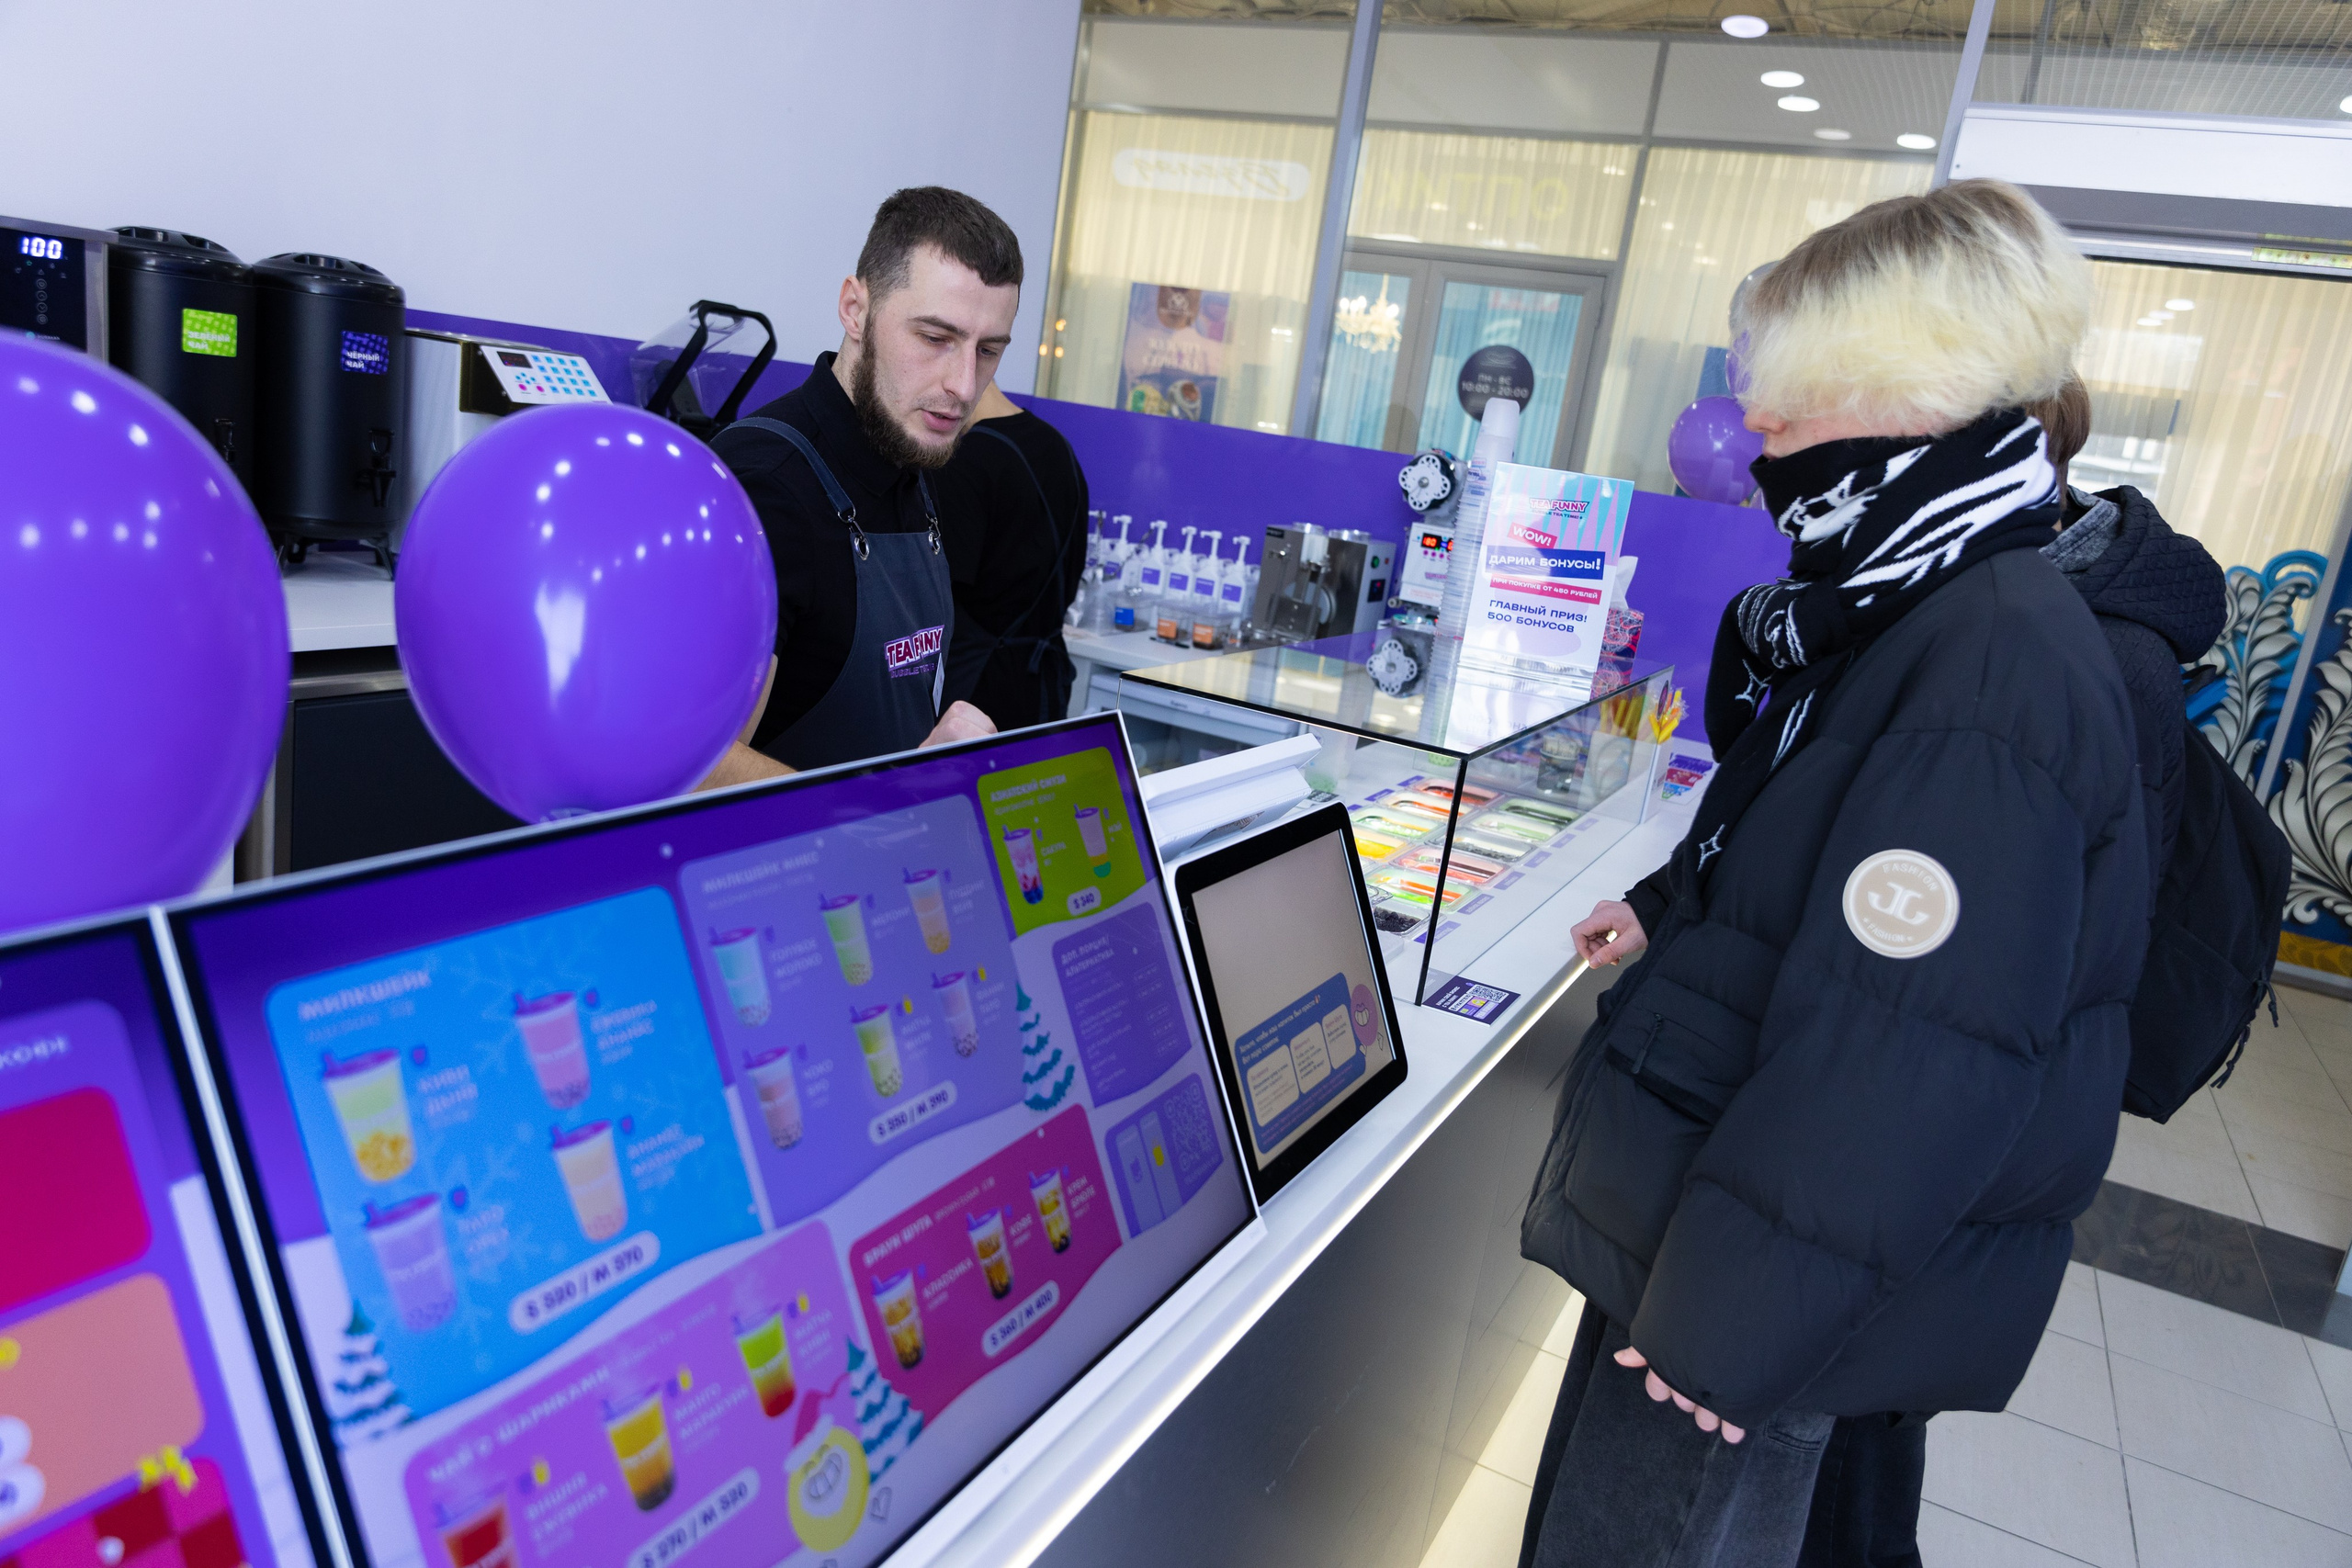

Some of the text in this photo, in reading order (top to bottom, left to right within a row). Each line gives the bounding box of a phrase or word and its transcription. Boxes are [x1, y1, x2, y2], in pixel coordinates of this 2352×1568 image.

[21, 237, 62, 260] 100
[345, 359, 365, 369] ЧАЙ
[1498, 385, 1530, 399] 20:00
[1530, 498, 1589, 513] TEA FUNNY
[1512, 525, 1552, 547] WOW!
[1488, 555, 1601, 570] ДАРИМ БОНУСЫ!
[1509, 580, 1541, 591] ПОКУПКЕ
[1570, 589, 1599, 600] РУБЛЕЙ
[1489, 599, 1588, 623] ГЛАВНЫЙ ПРИЗ!
[1487, 612, 1575, 633] 500 БОНУСОВ
[886, 627, 944, 669] TEA FNY
[1883, 863, 1940, 892] FASHION
[1867, 923, 1905, 942] FASHION
[916, 1100, 928, 1115] M
[593, 1263, 611, 1283] M
[989, 1332, 999, 1348] S
[1024, 1303, 1035, 1319] M
[701, 1506, 718, 1526] M
